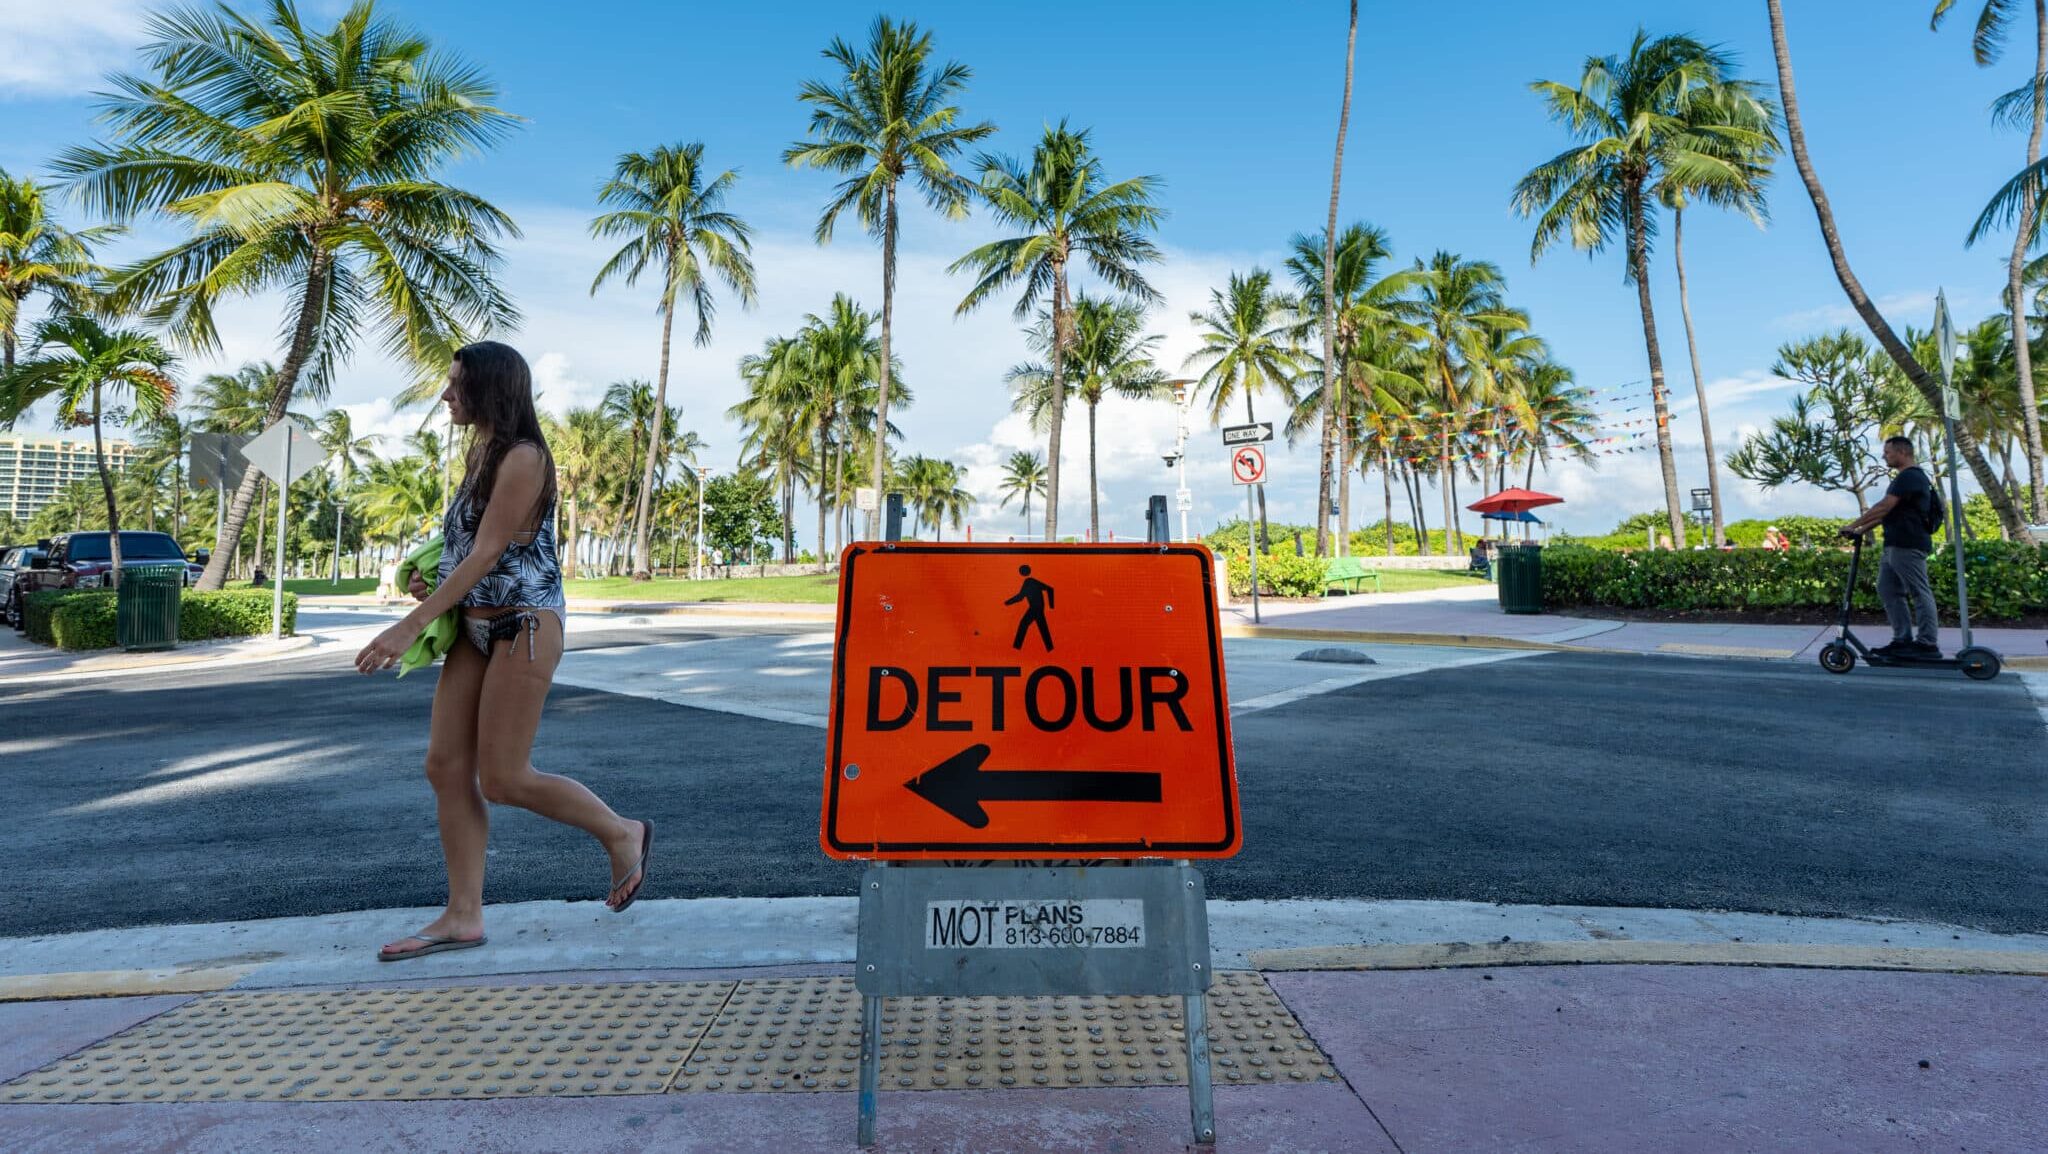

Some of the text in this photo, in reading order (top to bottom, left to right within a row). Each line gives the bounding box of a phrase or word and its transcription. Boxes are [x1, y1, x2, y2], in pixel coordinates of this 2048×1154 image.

[1226, 429, 1257, 440] ONE WAY
[865, 665, 1194, 733] DETOUR
[932, 905, 1084, 946] MOT PLANS
[1005, 926, 1141, 945] 813-600-7884
